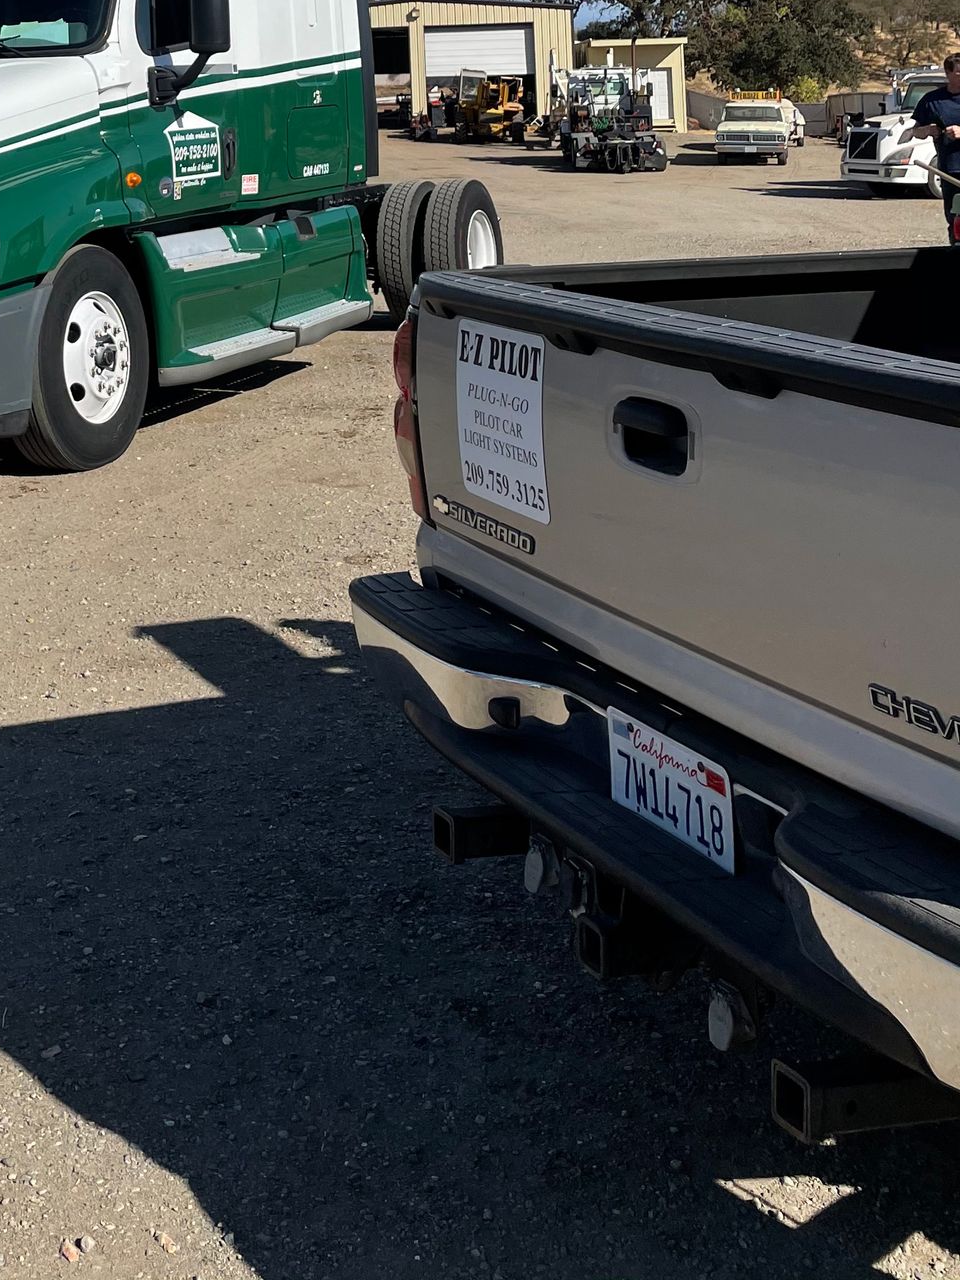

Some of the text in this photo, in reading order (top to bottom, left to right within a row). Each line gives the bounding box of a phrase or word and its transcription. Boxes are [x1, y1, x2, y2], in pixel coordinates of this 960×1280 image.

[731, 92, 759, 100] OVERSIZE
[459, 329, 542, 382] E-Z PILOT
[467, 383, 529, 415] PLUG-N-GO
[464, 429, 538, 468] LIGHT SYSTEMS
[474, 410, 523, 439] PILOT CAR
[465, 460, 546, 511] 209.759.3125
[448, 505, 536, 554] SILVERADO
[632, 728, 700, 778] California
[617, 748, 724, 856] 7W14718
